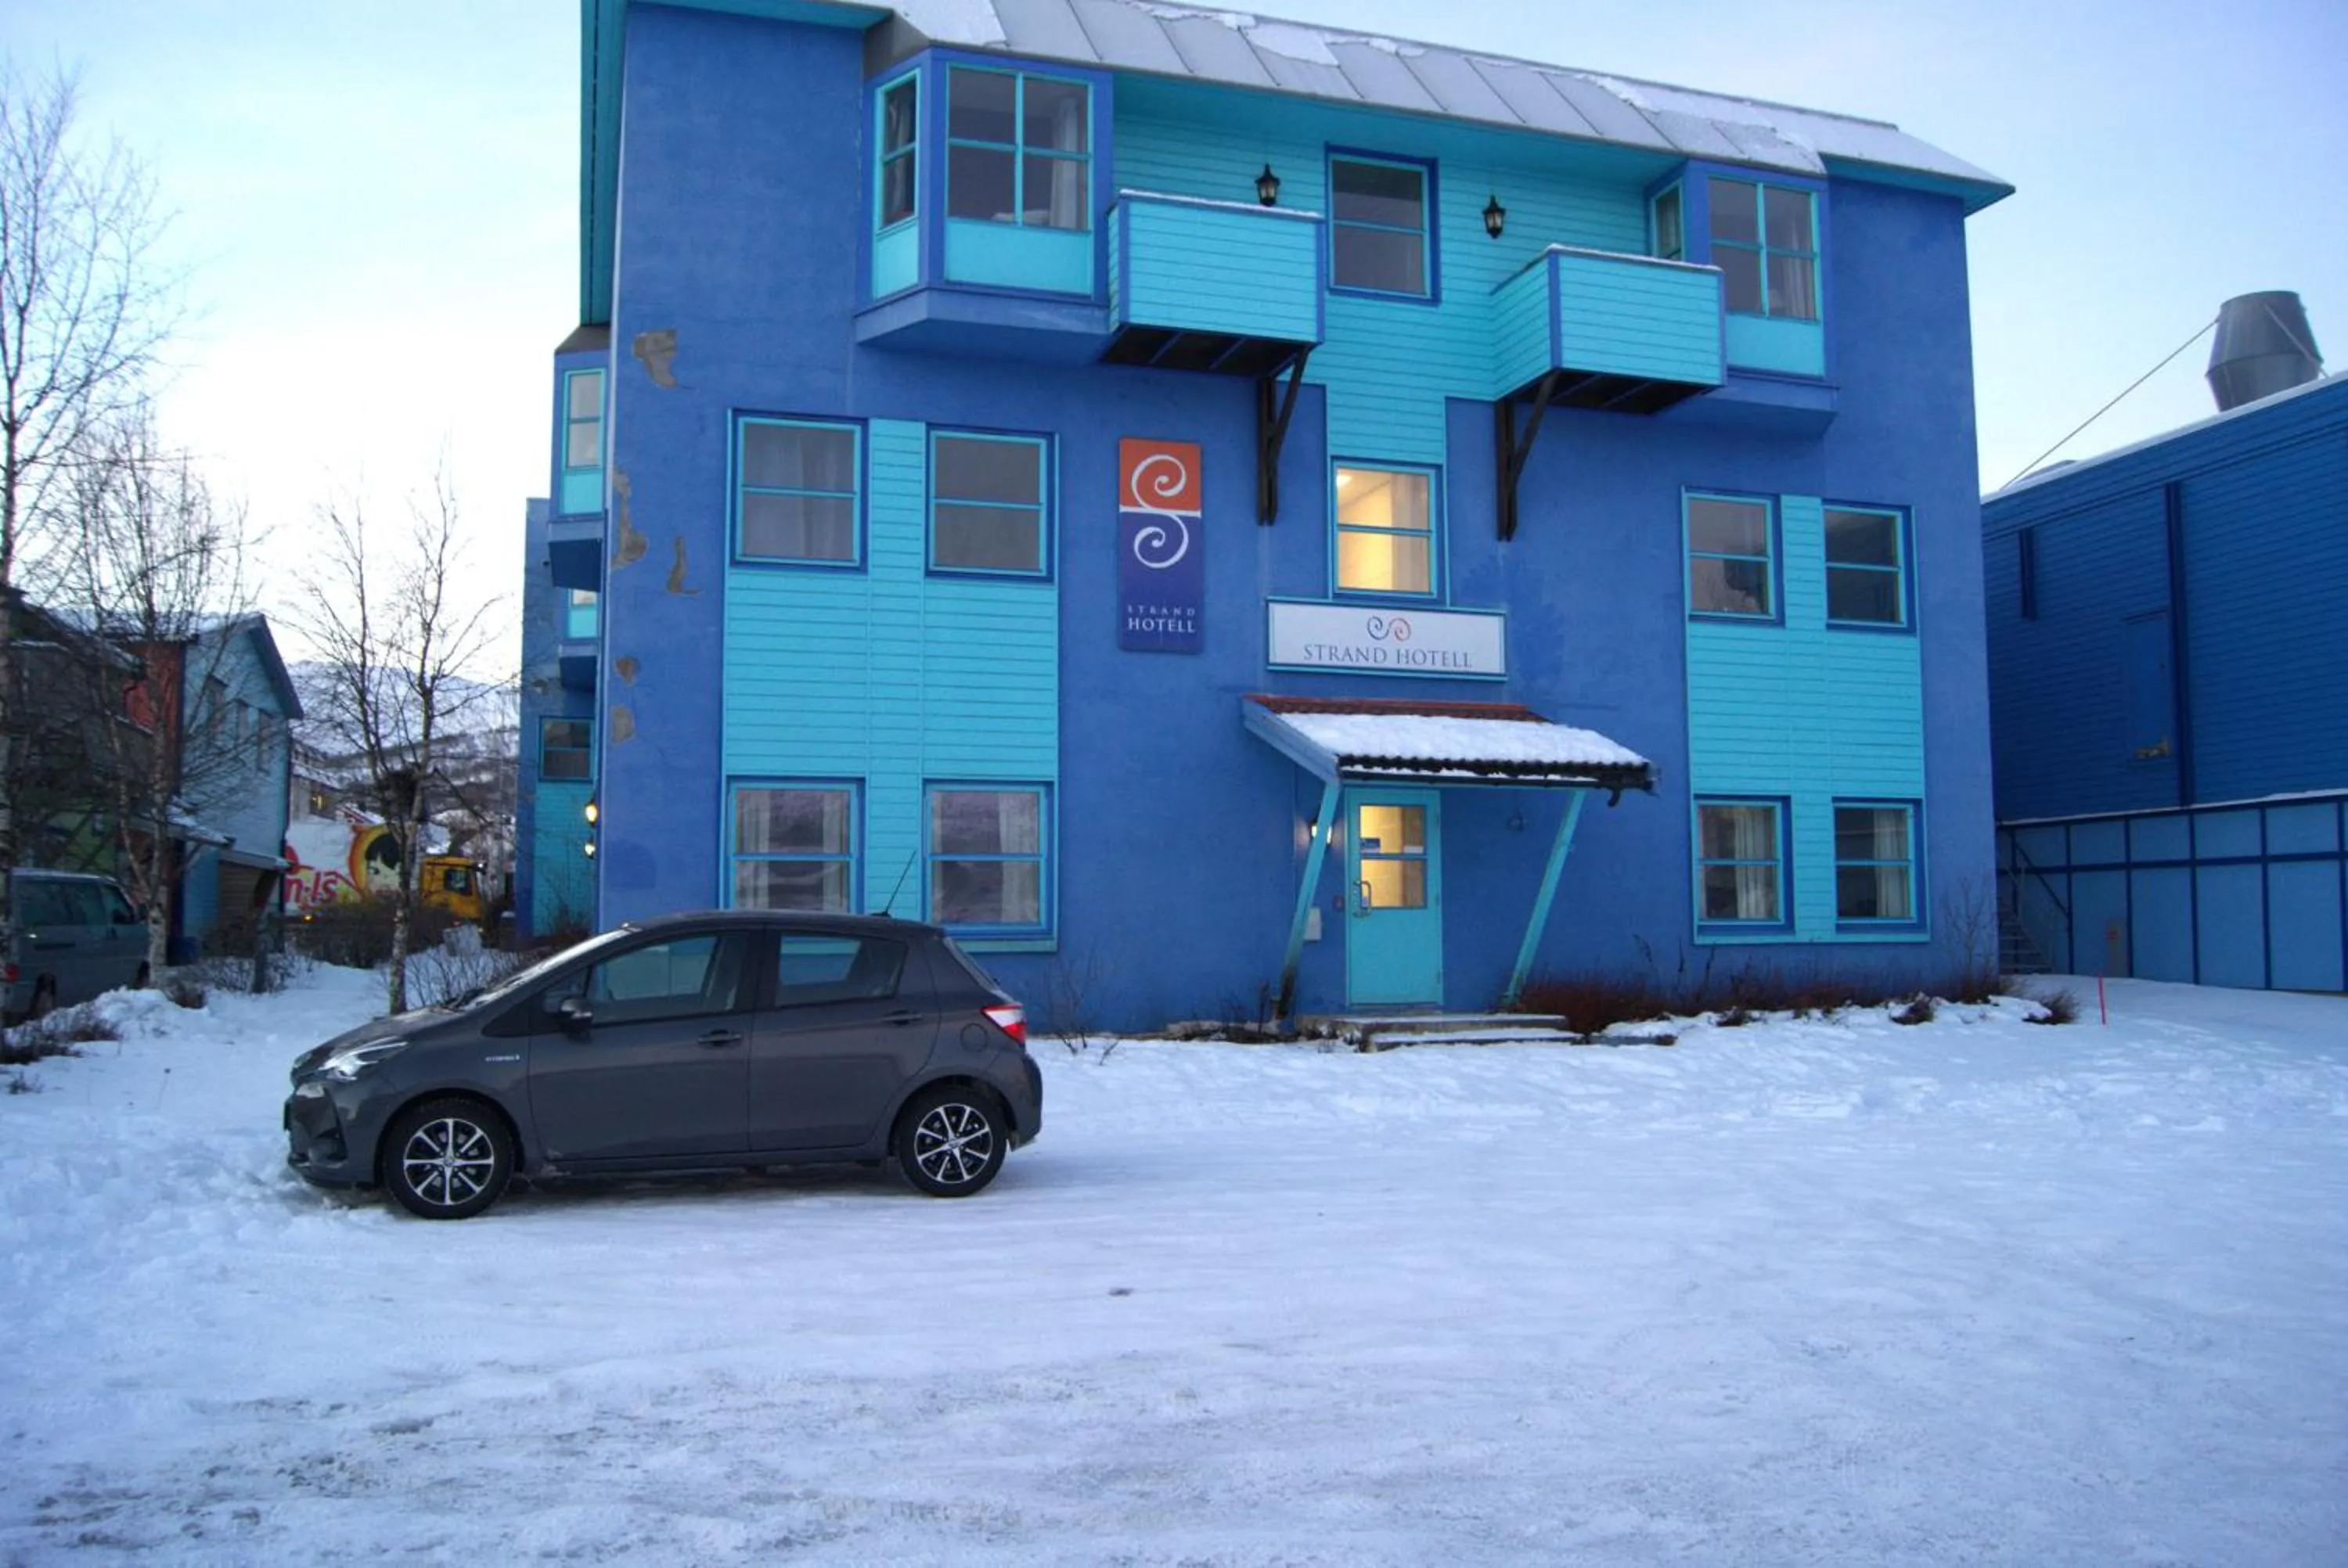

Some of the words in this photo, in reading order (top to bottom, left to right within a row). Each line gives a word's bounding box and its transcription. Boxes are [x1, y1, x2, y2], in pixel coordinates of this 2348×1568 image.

[1127, 604, 1196, 617] STRAND
[1128, 617, 1197, 634] HOTELL
[1303, 643, 1388, 664] STRAND
[1396, 648, 1473, 669] HOTELL
